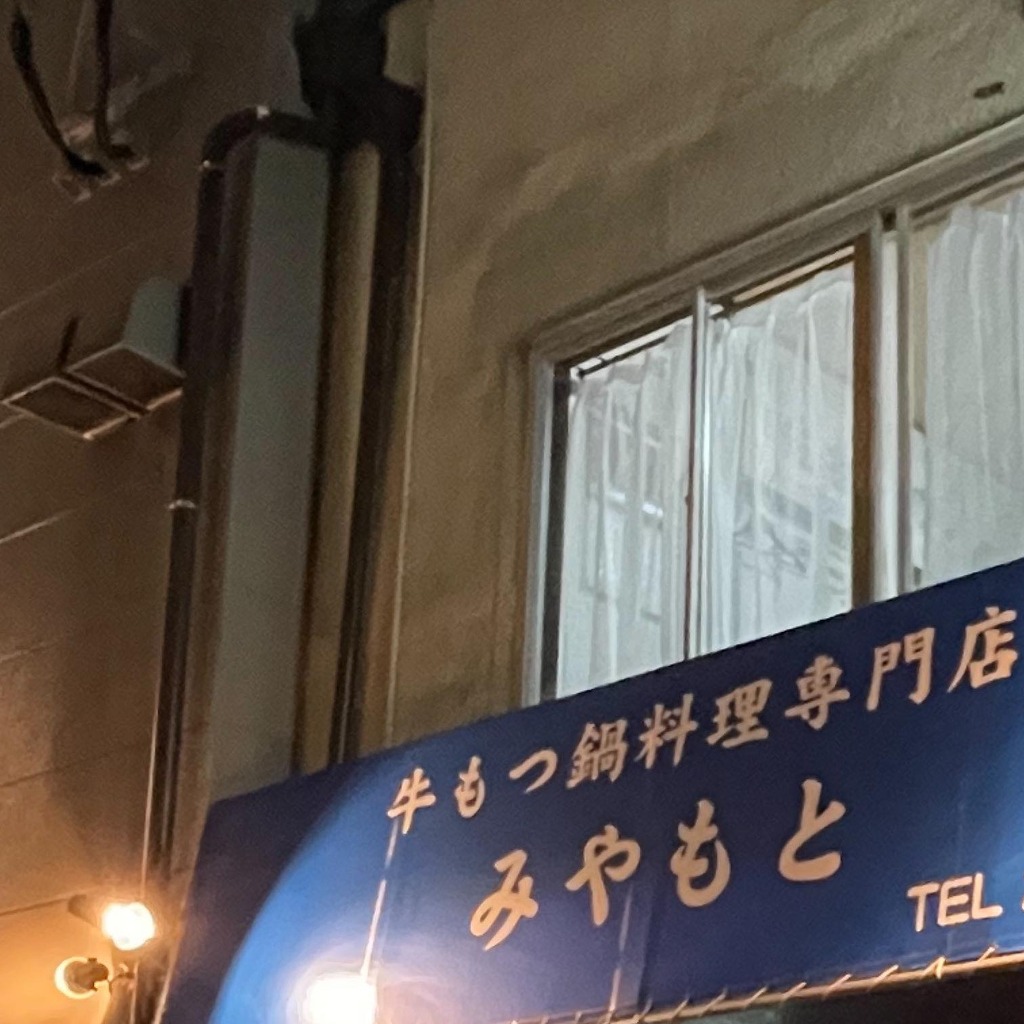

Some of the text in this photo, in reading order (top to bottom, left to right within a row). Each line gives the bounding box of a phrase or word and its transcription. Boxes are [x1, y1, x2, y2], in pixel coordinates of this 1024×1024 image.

[386, 606, 1019, 835] 牛もつ鍋料理専門店
[469, 779, 847, 950] みやもと
[907, 873, 1003, 932] TEL
